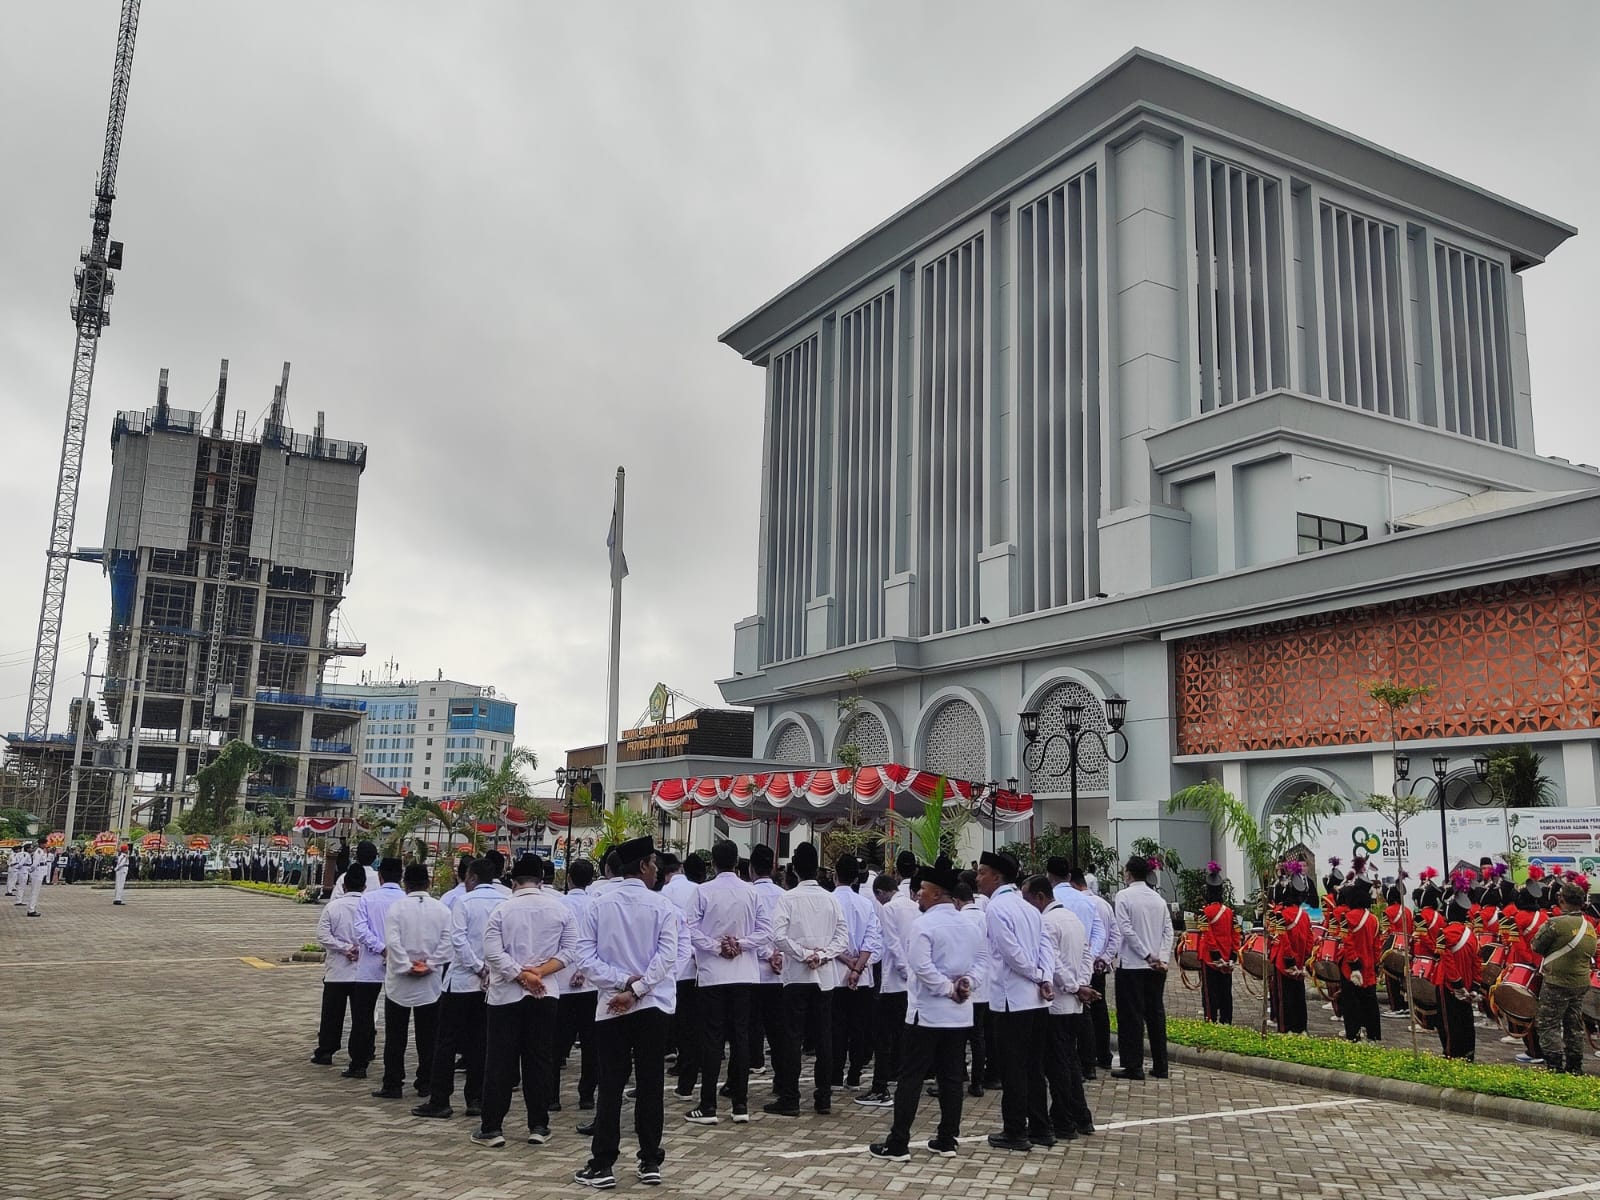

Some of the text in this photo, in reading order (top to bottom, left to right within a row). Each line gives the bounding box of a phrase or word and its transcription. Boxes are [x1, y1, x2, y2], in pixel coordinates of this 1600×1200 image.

[675, 719, 698, 730] AGAMA
[627, 734, 689, 751] PROVINSI JAWA TENGAH
[1381, 828, 1402, 838] Hari
[1382, 837, 1409, 847] Amal
